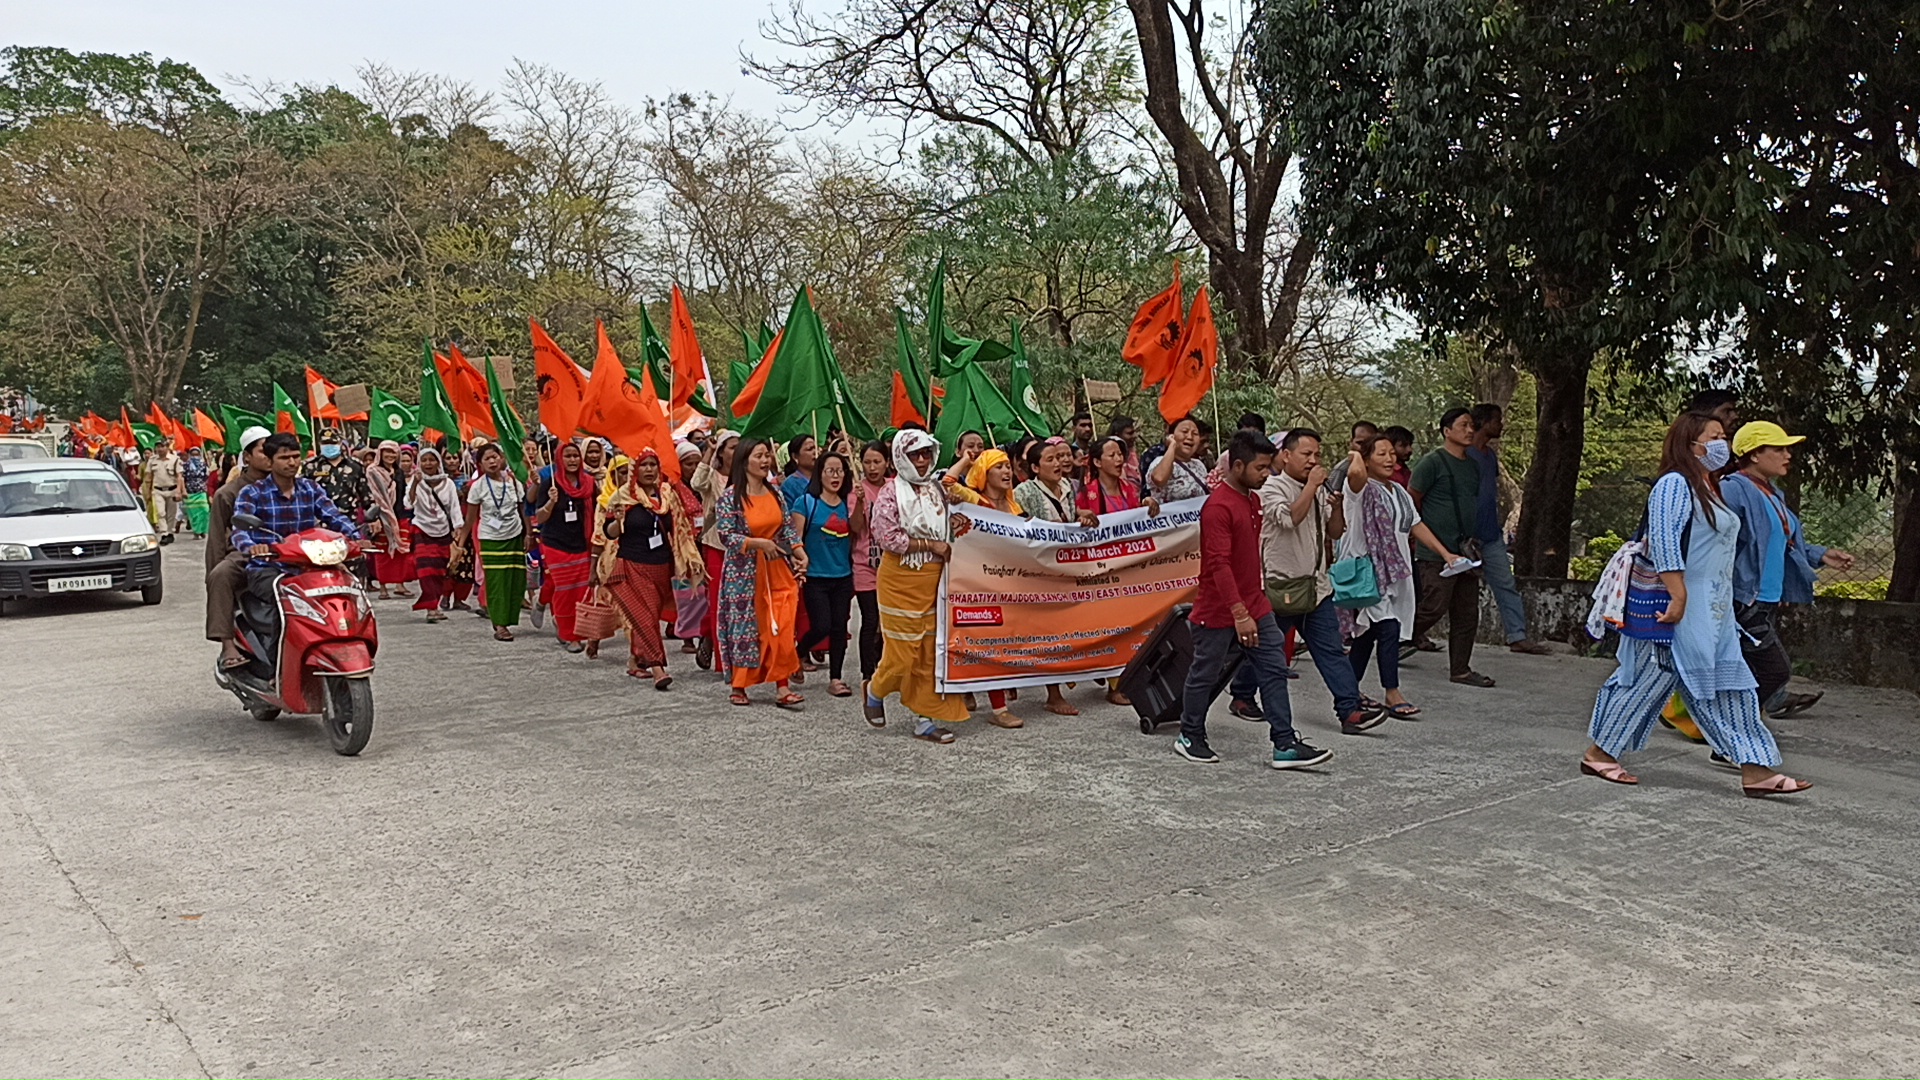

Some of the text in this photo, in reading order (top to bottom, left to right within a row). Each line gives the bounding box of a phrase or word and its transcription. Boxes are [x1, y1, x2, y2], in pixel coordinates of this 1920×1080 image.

[973, 518, 1025, 539] PEACEFULL
[1024, 528, 1047, 541] MASS
[1112, 522, 1134, 538] MAIN
[1134, 516, 1170, 533] MARKET
[1057, 549, 1069, 561] On
[1125, 539, 1152, 554] 2021
[1111, 575, 1120, 584] to
[949, 593, 998, 603] BHARATIYA
[1070, 590, 1095, 602] (BMS)
[1096, 587, 1120, 599] EAST
[1122, 584, 1153, 596] SIANG
[1154, 577, 1200, 592] DISTRICT
[956, 609, 993, 620] Demands
[1027, 634, 1060, 643] damages
